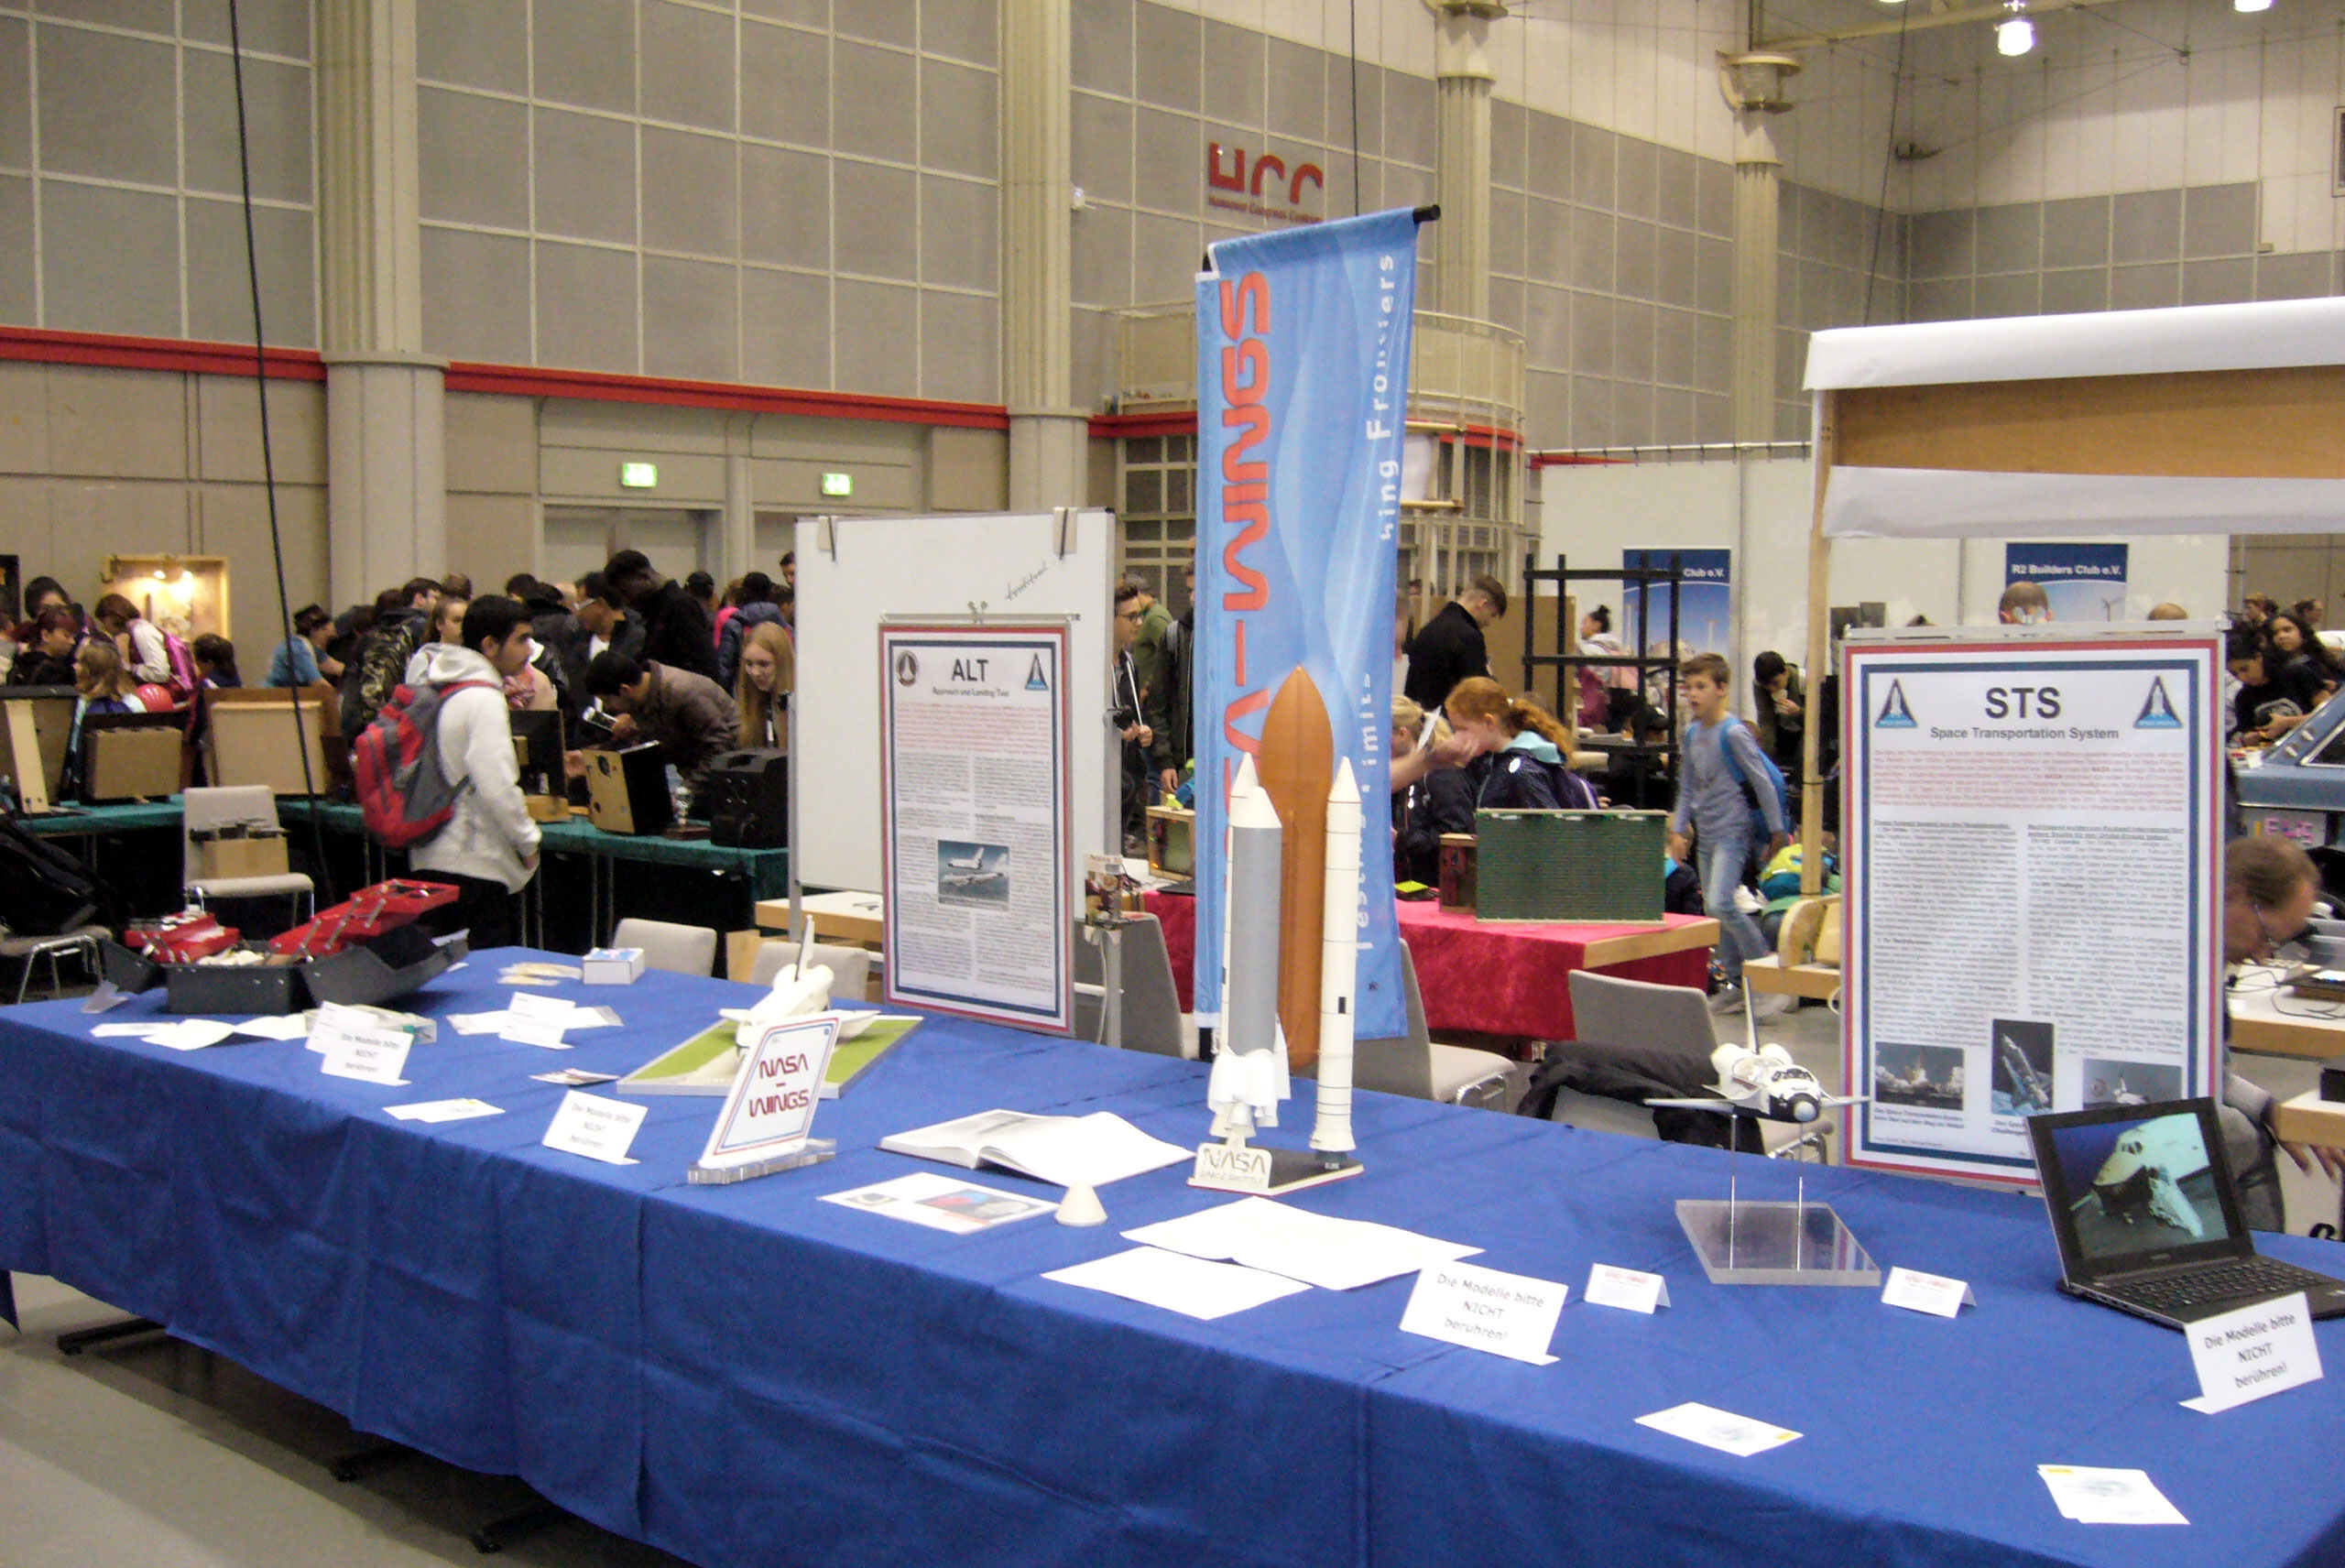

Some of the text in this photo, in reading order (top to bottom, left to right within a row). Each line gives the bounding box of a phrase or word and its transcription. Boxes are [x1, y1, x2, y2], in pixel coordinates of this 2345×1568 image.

[1682, 568, 1706, 578] Club
[2012, 564, 2121, 575] R2 Builders Club e.V.
[952, 659, 988, 682] ALT
[1985, 687, 2061, 720] STS
[1930, 727, 2119, 741] Space Transportation System
[759, 1053, 809, 1079] NASA
[749, 1089, 810, 1117] WINGS
[1204, 1148, 1265, 1173] NASA
[1436, 1273, 1544, 1308] Die Modelle bitte
[1463, 1301, 1505, 1319] NICHT
[2204, 1314, 2296, 1350] Die Modelle bitte
[2237, 1342, 2274, 1363] NICHT
[2234, 1361, 2288, 1388] berühren!
